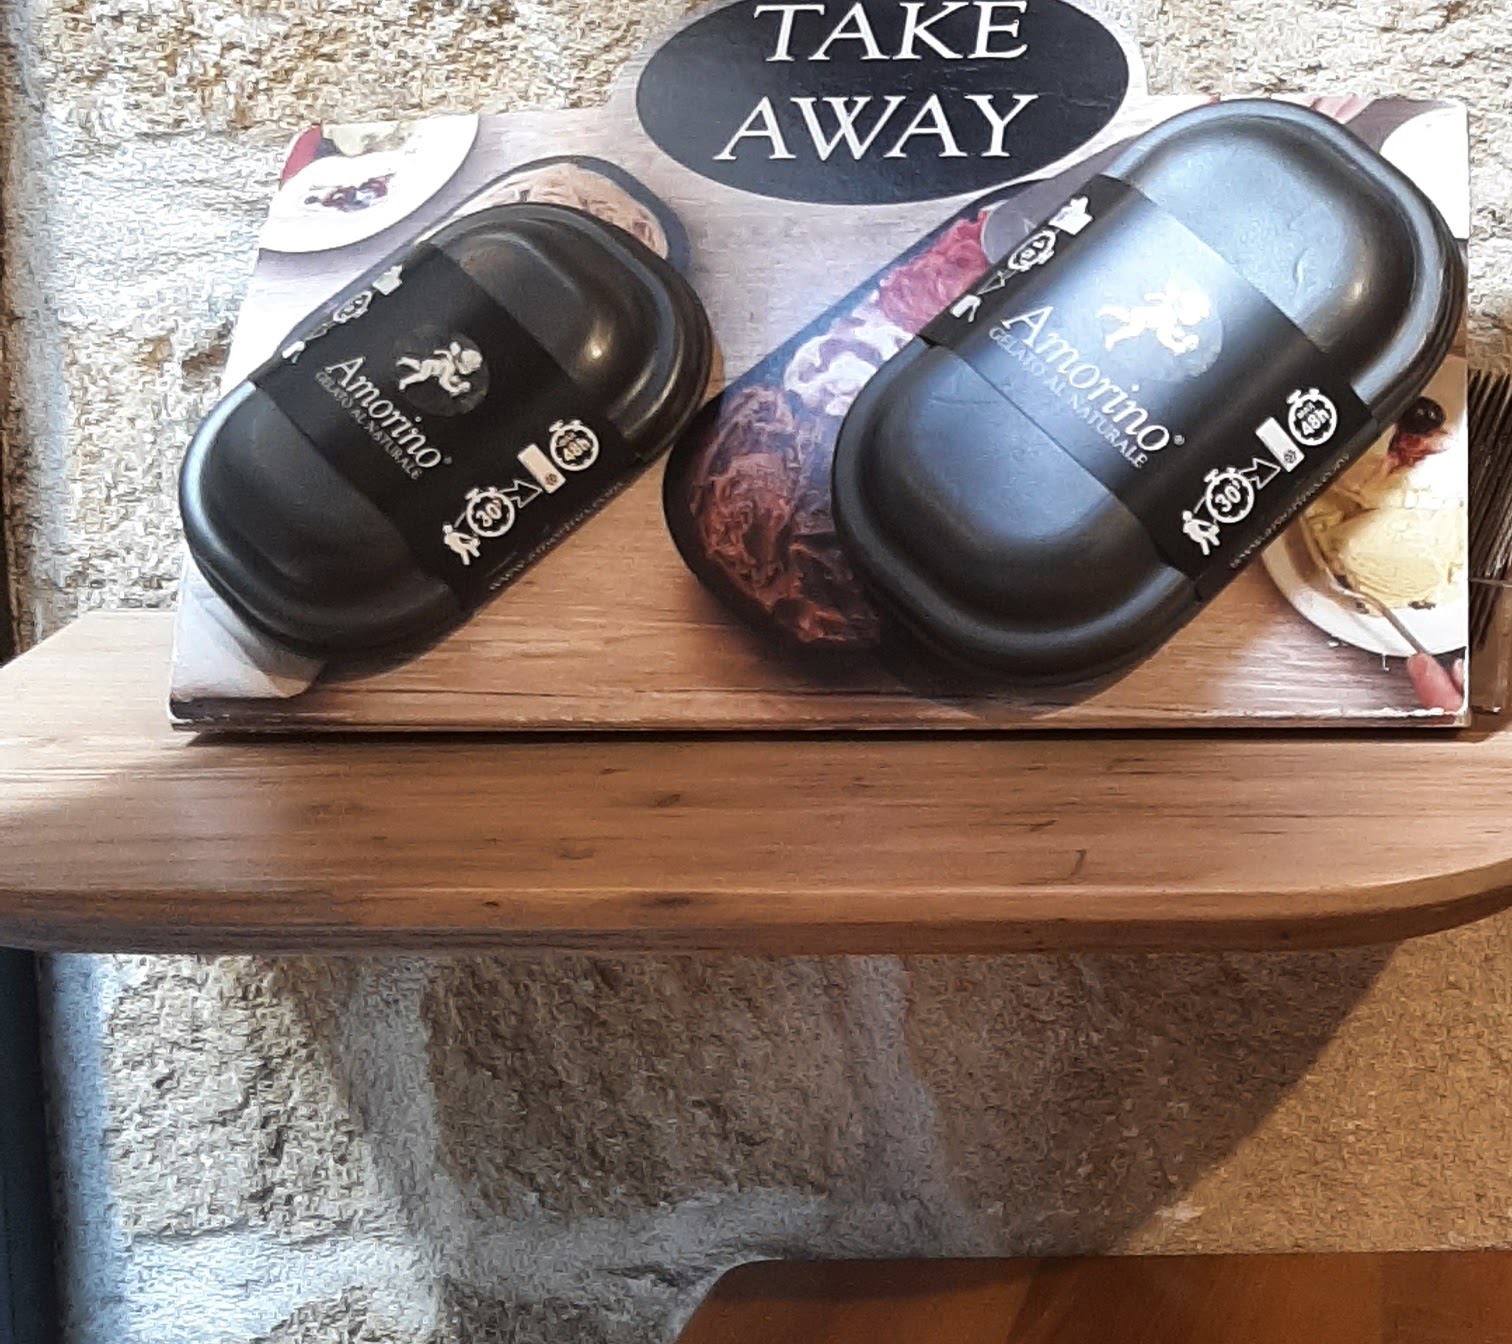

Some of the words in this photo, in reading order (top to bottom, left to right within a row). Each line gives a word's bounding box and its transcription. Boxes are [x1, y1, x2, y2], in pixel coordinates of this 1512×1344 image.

[753, 0, 1028, 62] TAKE
[712, 94, 1040, 161] AWAY
[1070, 393, 1149, 469] NATURALE
[1301, 409, 1330, 436] 48h
